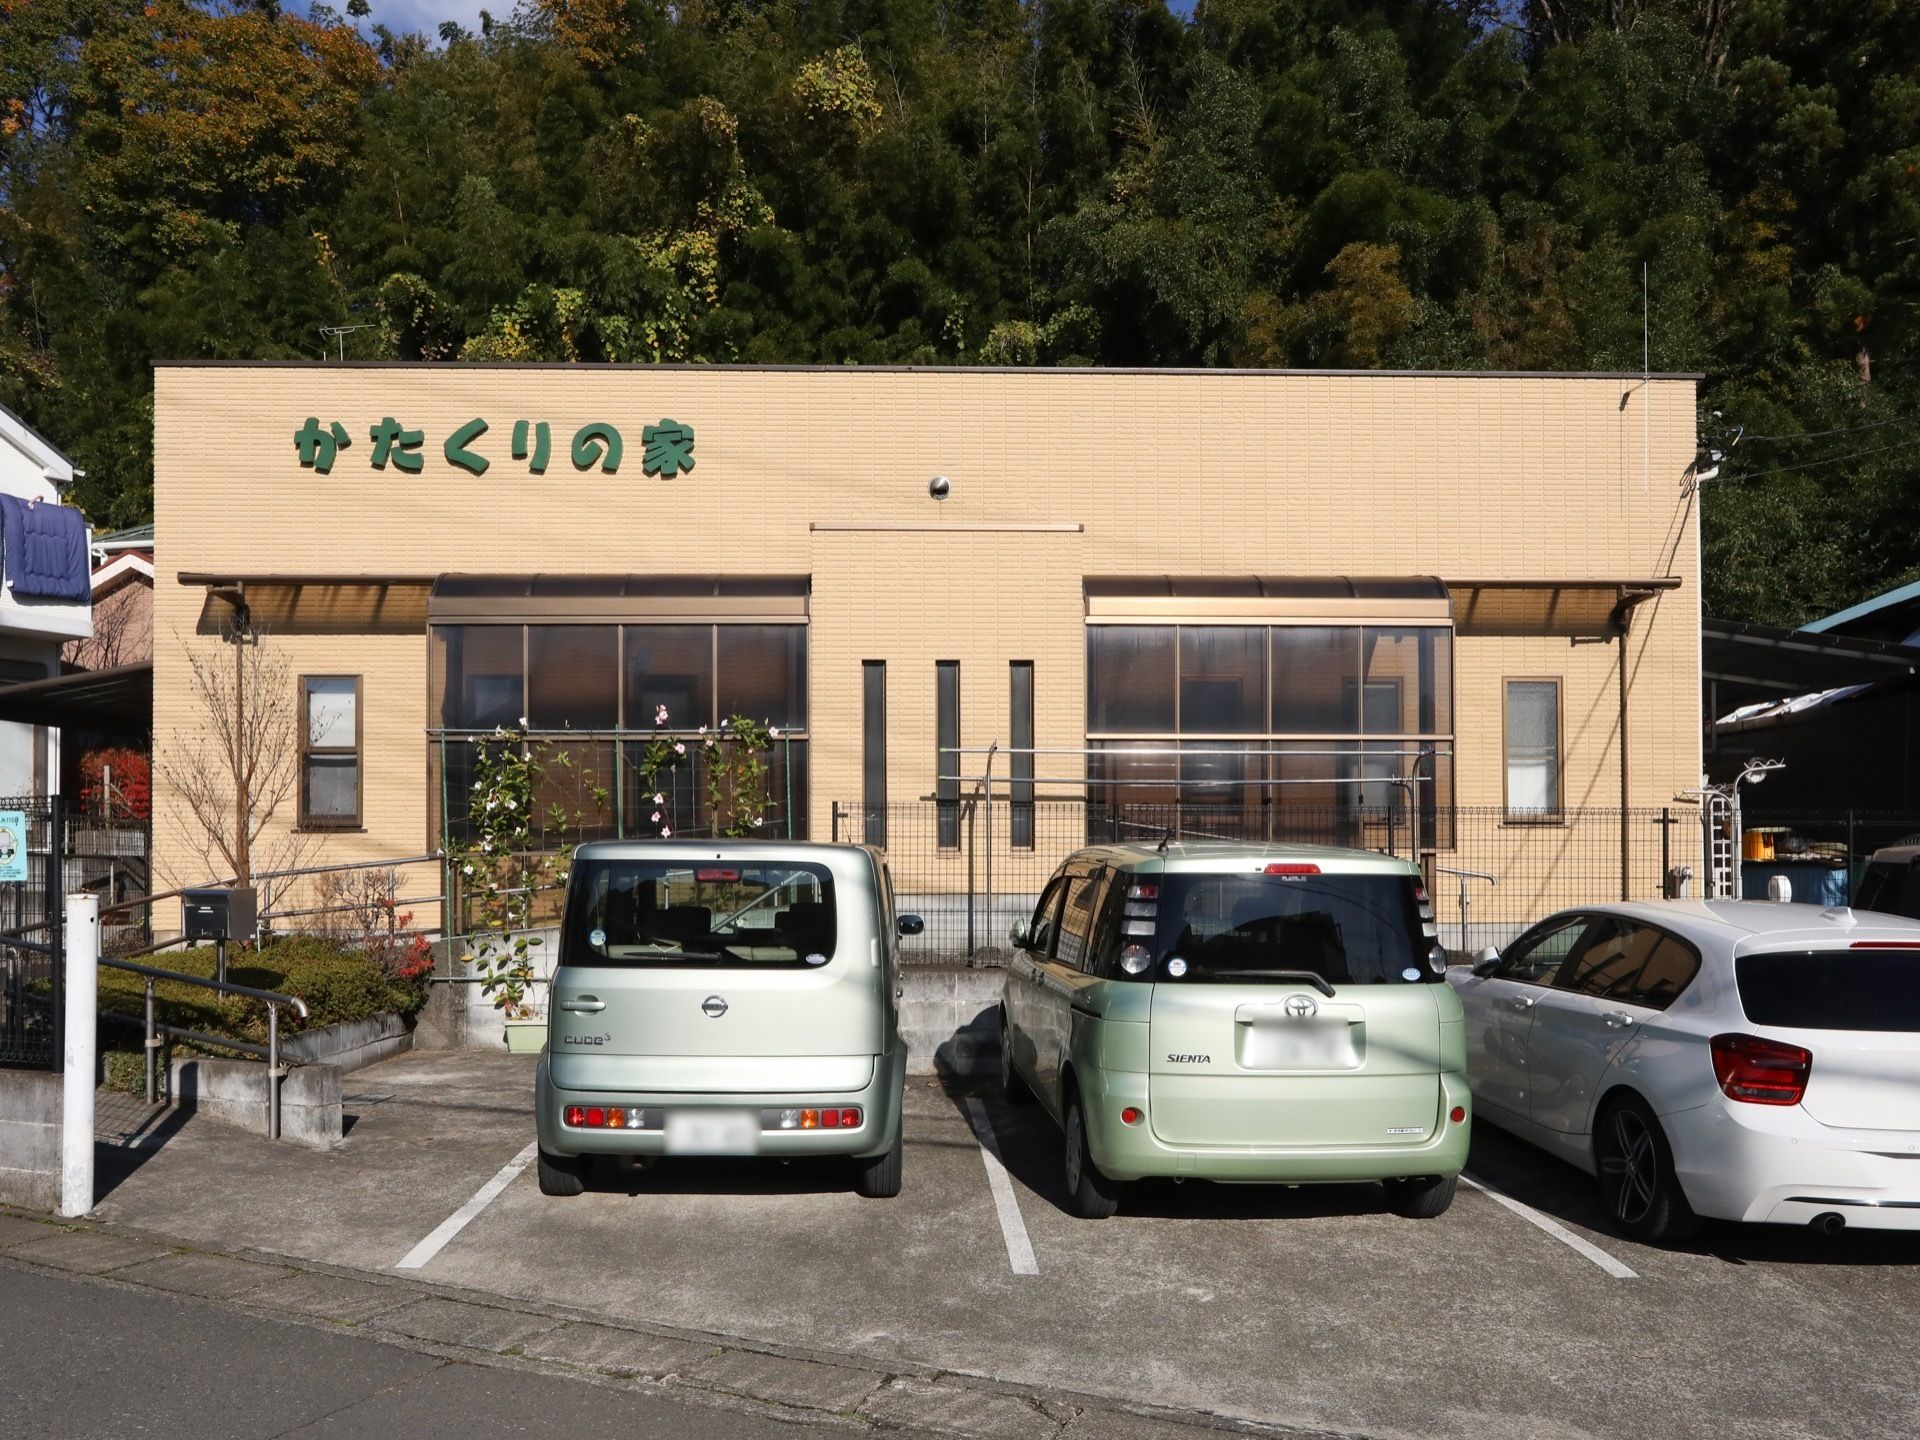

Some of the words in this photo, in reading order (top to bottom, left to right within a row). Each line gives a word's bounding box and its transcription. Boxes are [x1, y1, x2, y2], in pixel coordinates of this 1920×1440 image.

[294, 417, 696, 479] かたくりの家
[1166, 1054, 1211, 1063] SIENTA
